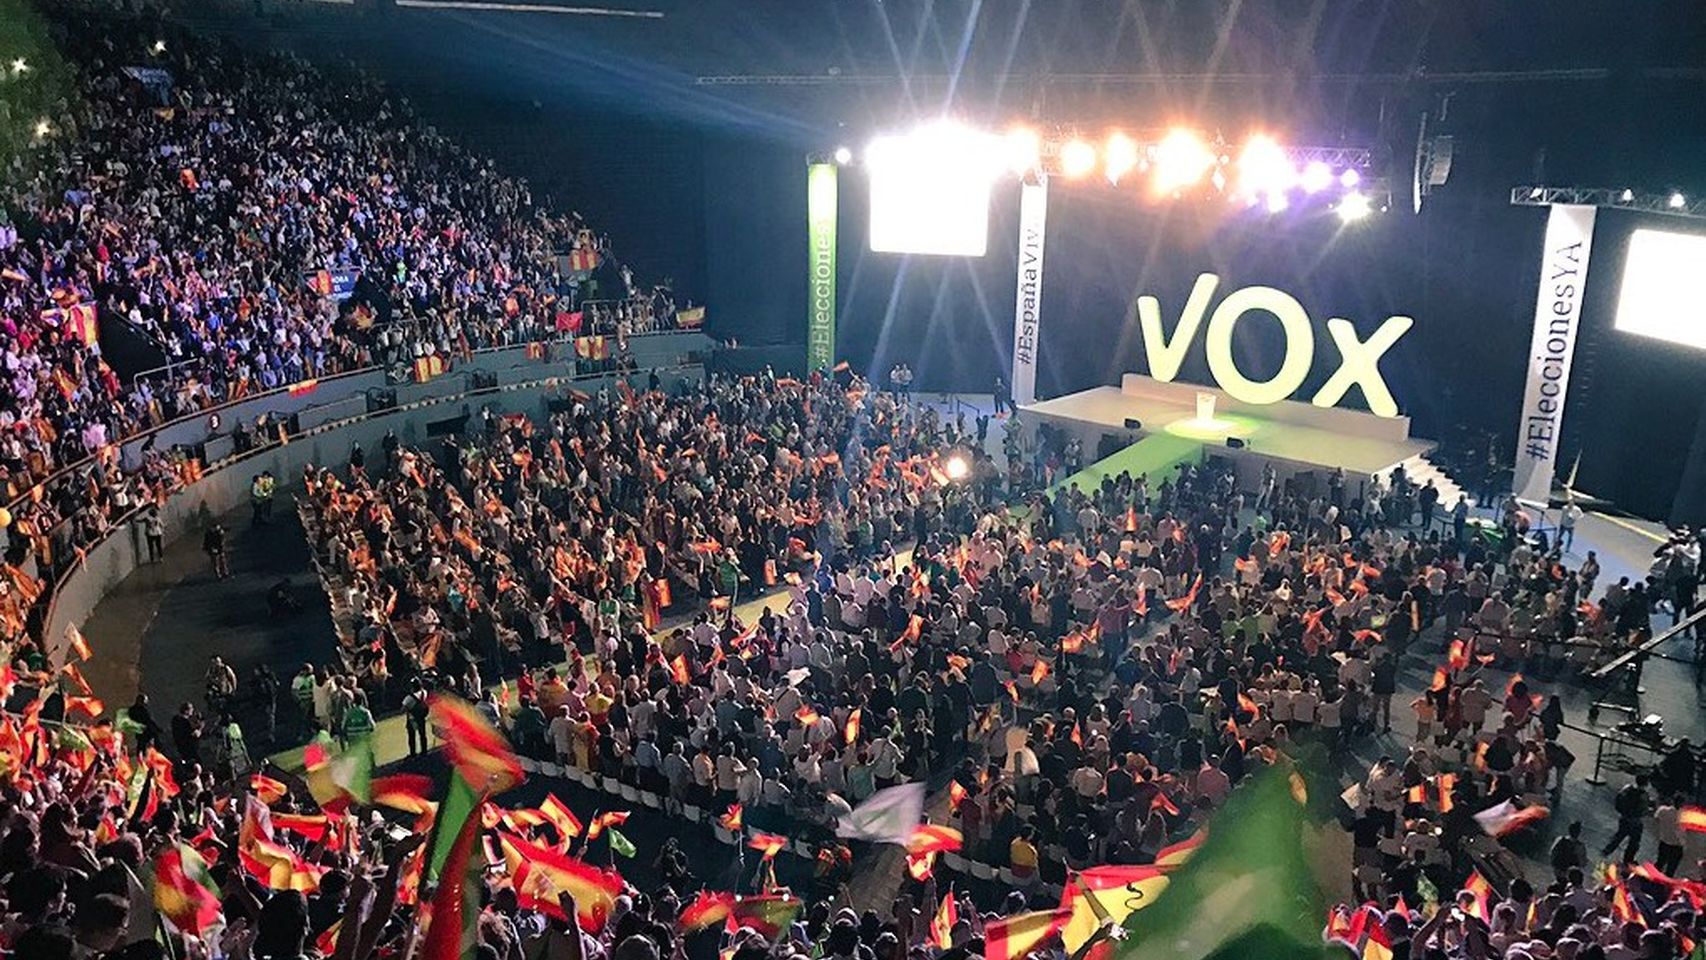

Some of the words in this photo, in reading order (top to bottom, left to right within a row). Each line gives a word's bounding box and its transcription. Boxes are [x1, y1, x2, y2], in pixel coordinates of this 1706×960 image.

[1017, 219, 1039, 366] #EspañaViv
[1137, 272, 1415, 418] VOX
[1525, 240, 1583, 461] #EleccionesYA
